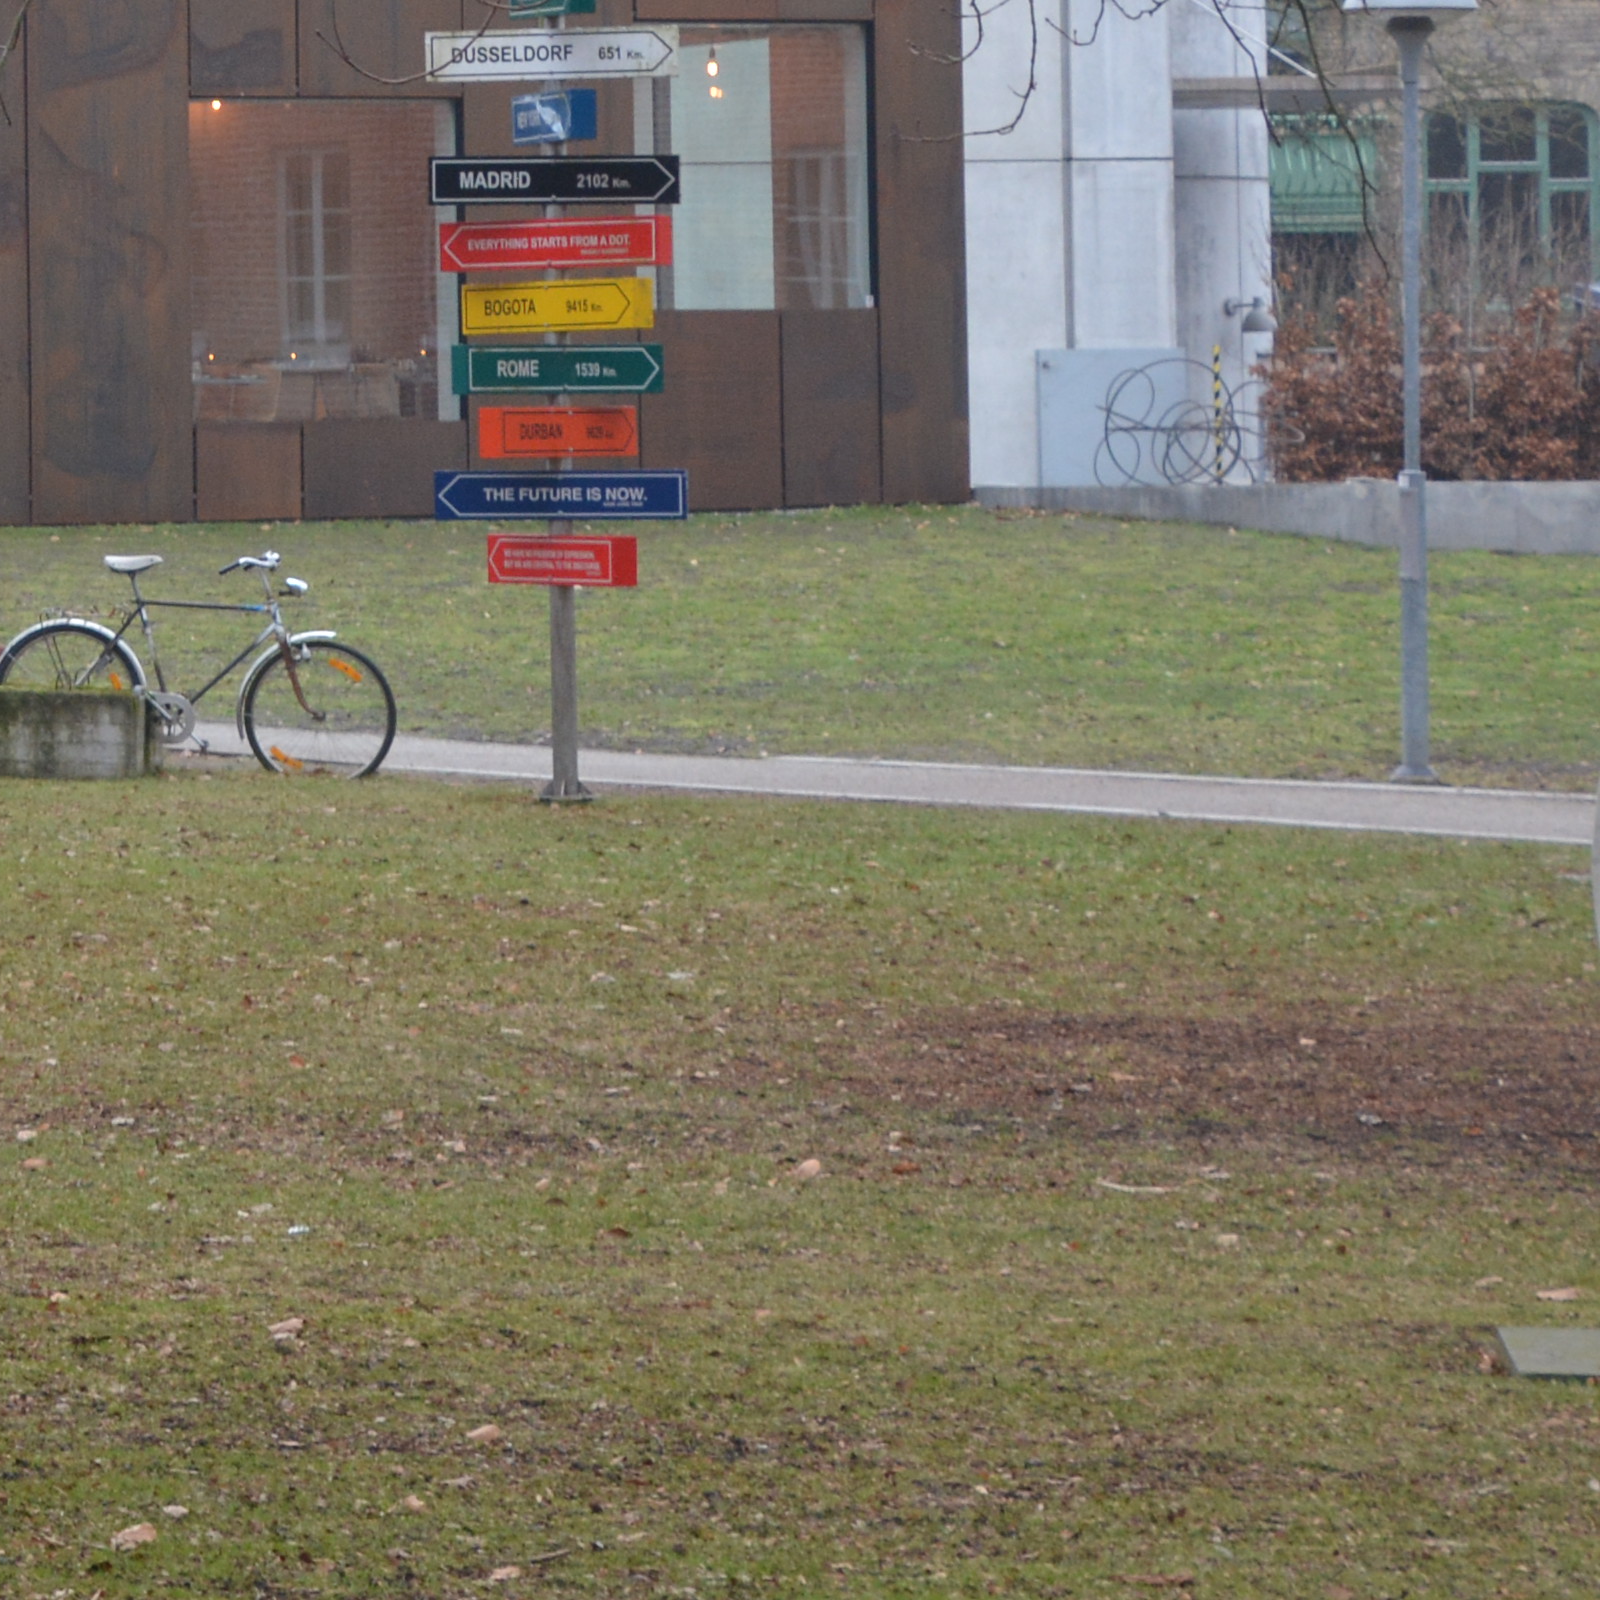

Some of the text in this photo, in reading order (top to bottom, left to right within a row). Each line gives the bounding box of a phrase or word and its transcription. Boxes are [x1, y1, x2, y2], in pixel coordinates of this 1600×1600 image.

[598, 47, 621, 60] 651
[459, 171, 531, 189] MADRID
[576, 174, 609, 188] 2102
[467, 238, 528, 251] EVERYTHING
[531, 236, 568, 249] STARTS
[570, 235, 598, 247] FROM
[600, 234, 607, 246] A
[484, 299, 536, 316] BOGOTA
[566, 299, 588, 313] 9415
[497, 360, 539, 377] ROME
[575, 362, 600, 377] 1539
[519, 423, 562, 440] DURBAN
[484, 487, 647, 501] THE FUTURE IS NOW.
